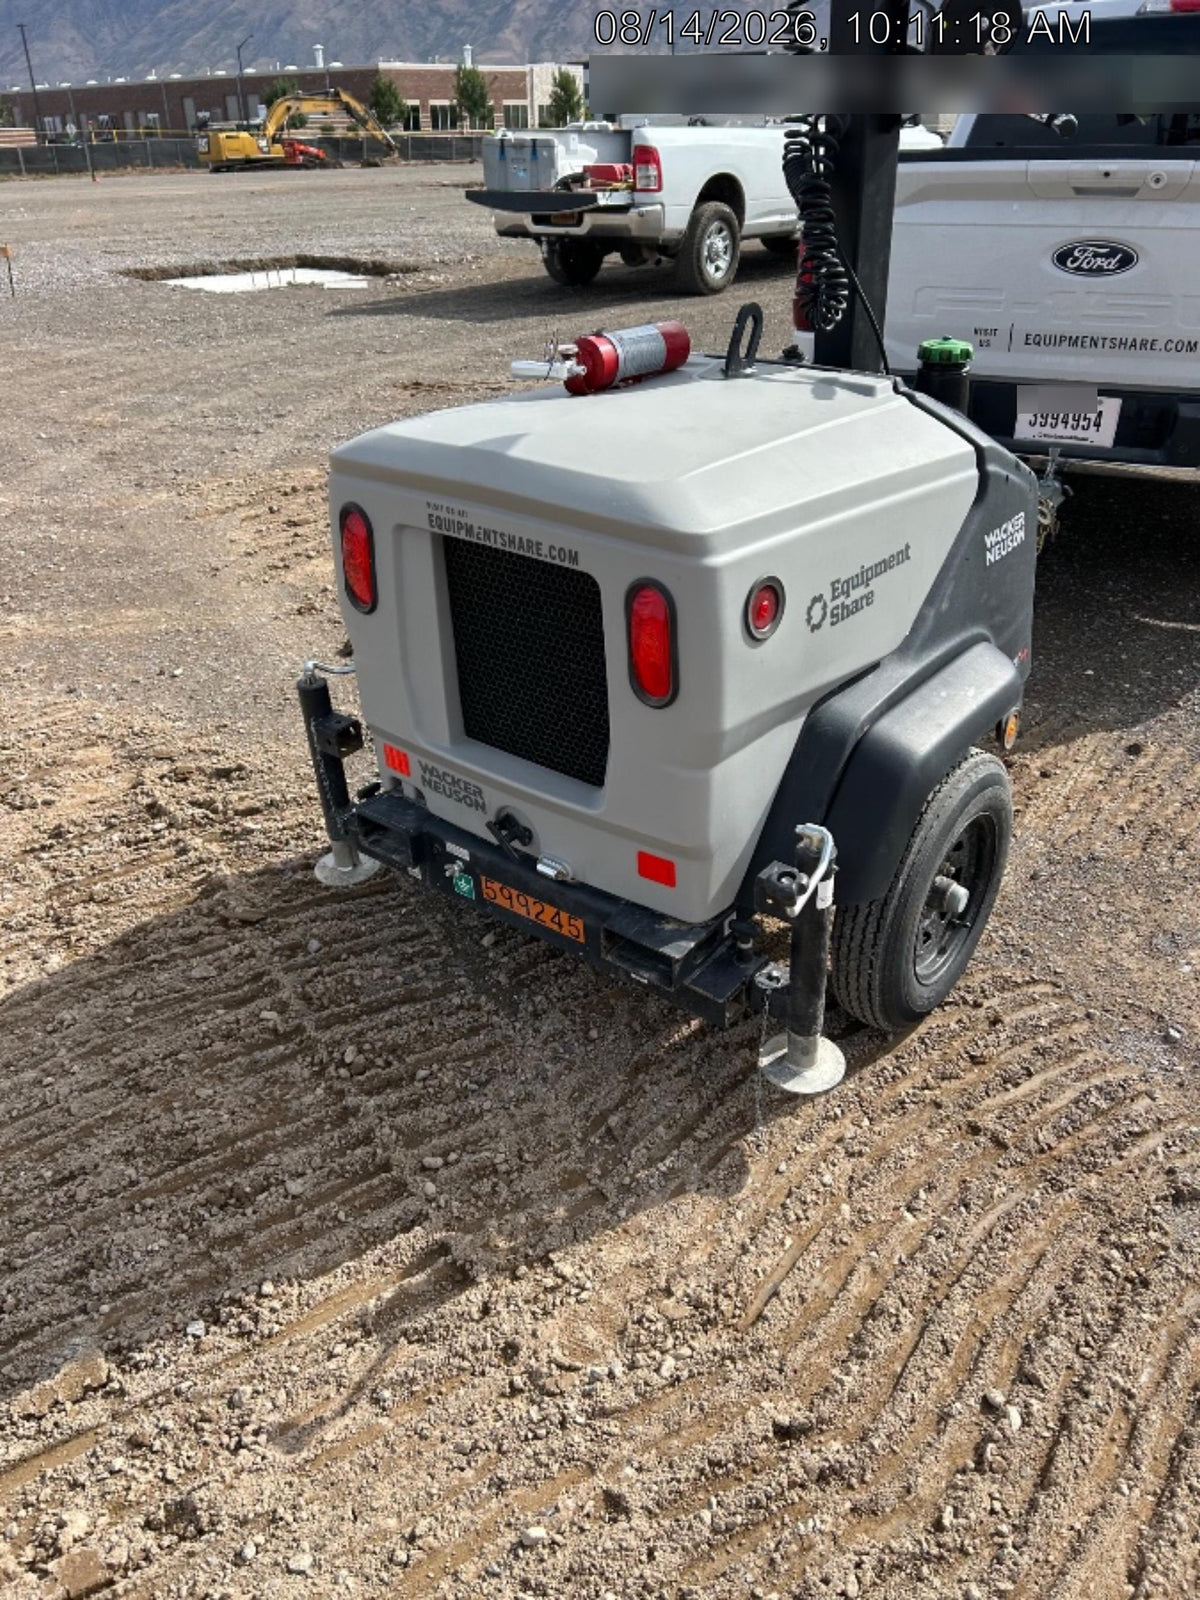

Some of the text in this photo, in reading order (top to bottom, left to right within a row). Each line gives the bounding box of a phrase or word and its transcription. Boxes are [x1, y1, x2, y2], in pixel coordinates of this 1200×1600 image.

[1066, 246, 1122, 268] Ford
[1024, 332, 1199, 353] EQUIPMENTSHARE.COM
[428, 513, 579, 566] EQUIPMENTSHARE.COM
[984, 511, 1025, 549] WACKER
[986, 527, 1025, 567] NEUSON
[830, 541, 912, 602] Equipment
[829, 589, 875, 627] Share
[417, 759, 485, 800] WACKER
[421, 774, 487, 814] NEUSON
[484, 878, 585, 941] 599245
